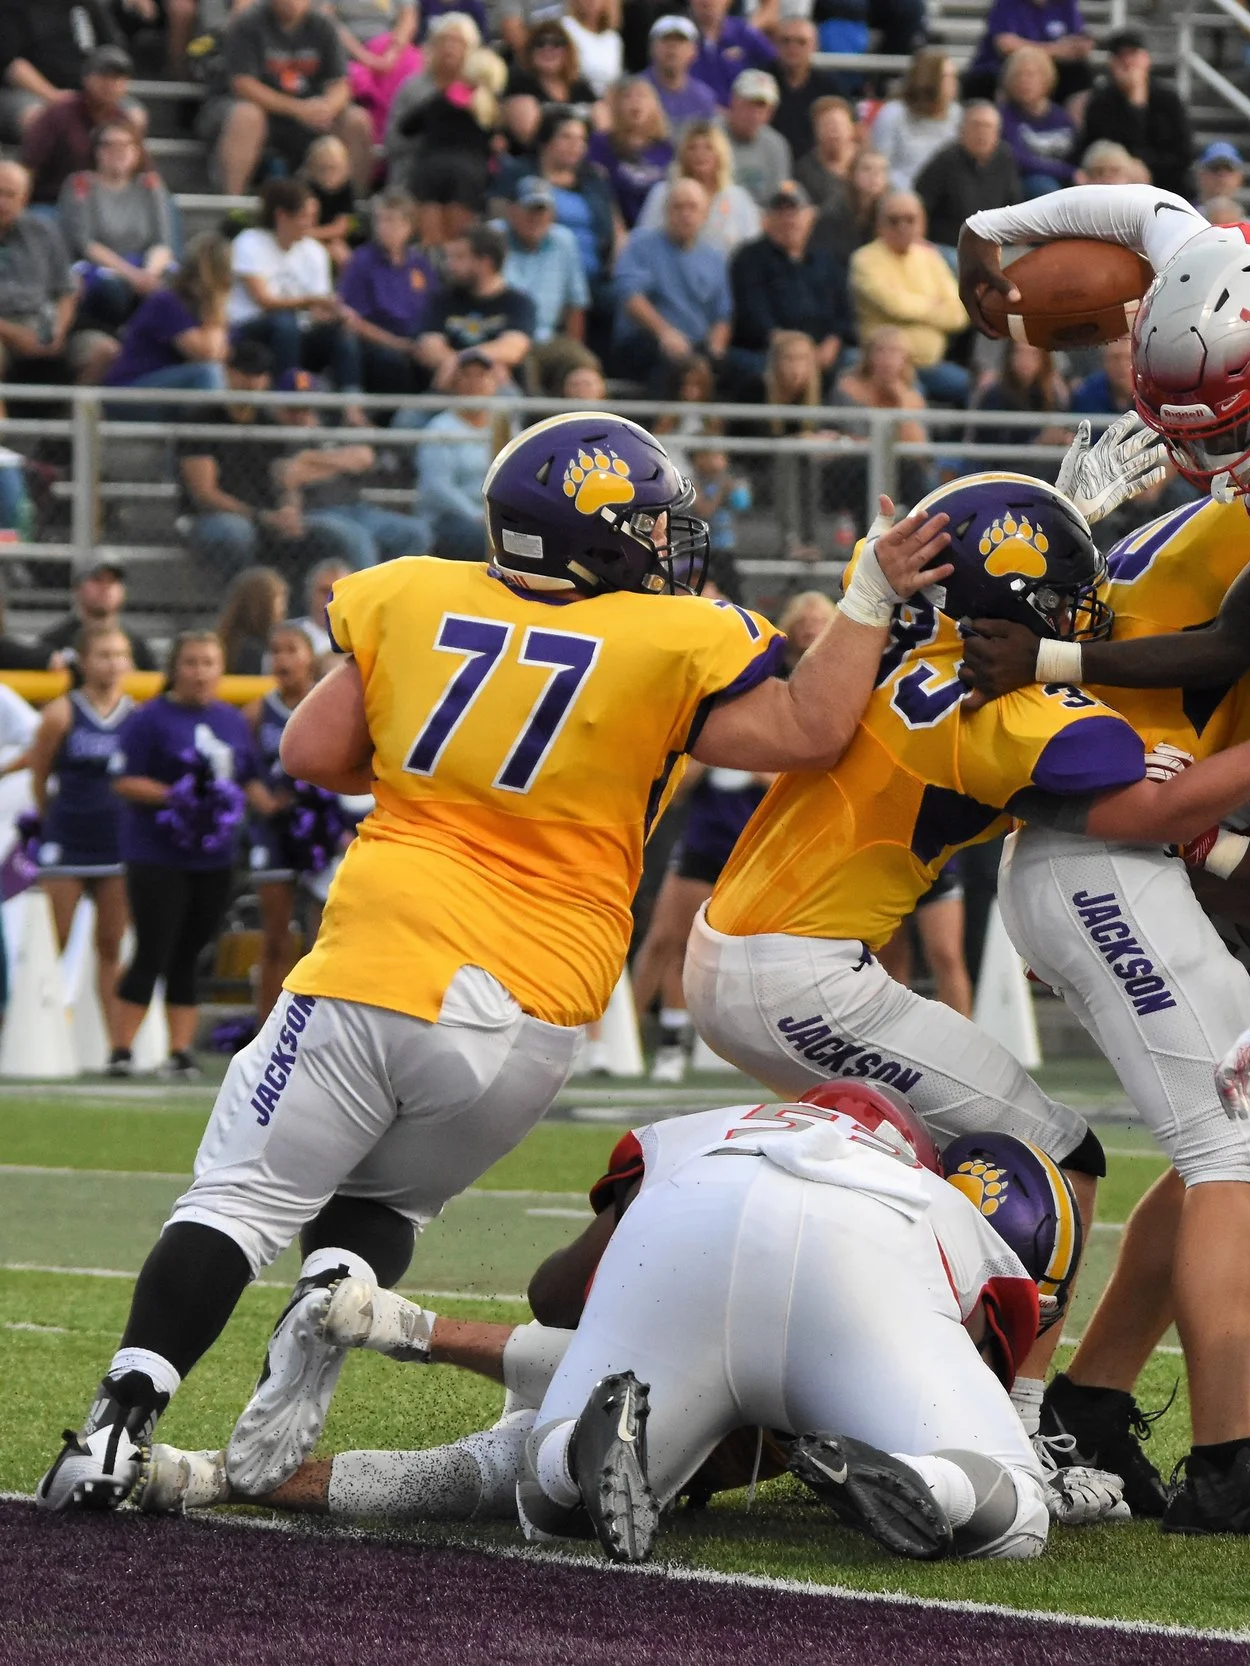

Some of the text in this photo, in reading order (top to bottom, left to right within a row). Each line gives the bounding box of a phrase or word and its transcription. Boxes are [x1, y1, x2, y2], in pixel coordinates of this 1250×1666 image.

[402, 611, 604, 795] 77
[1041, 682, 1118, 710] 3
[1072, 890, 1178, 1016] JACKSON
[250, 994, 317, 1127] JACKSON
[776, 1014, 924, 1094] JACKSON
